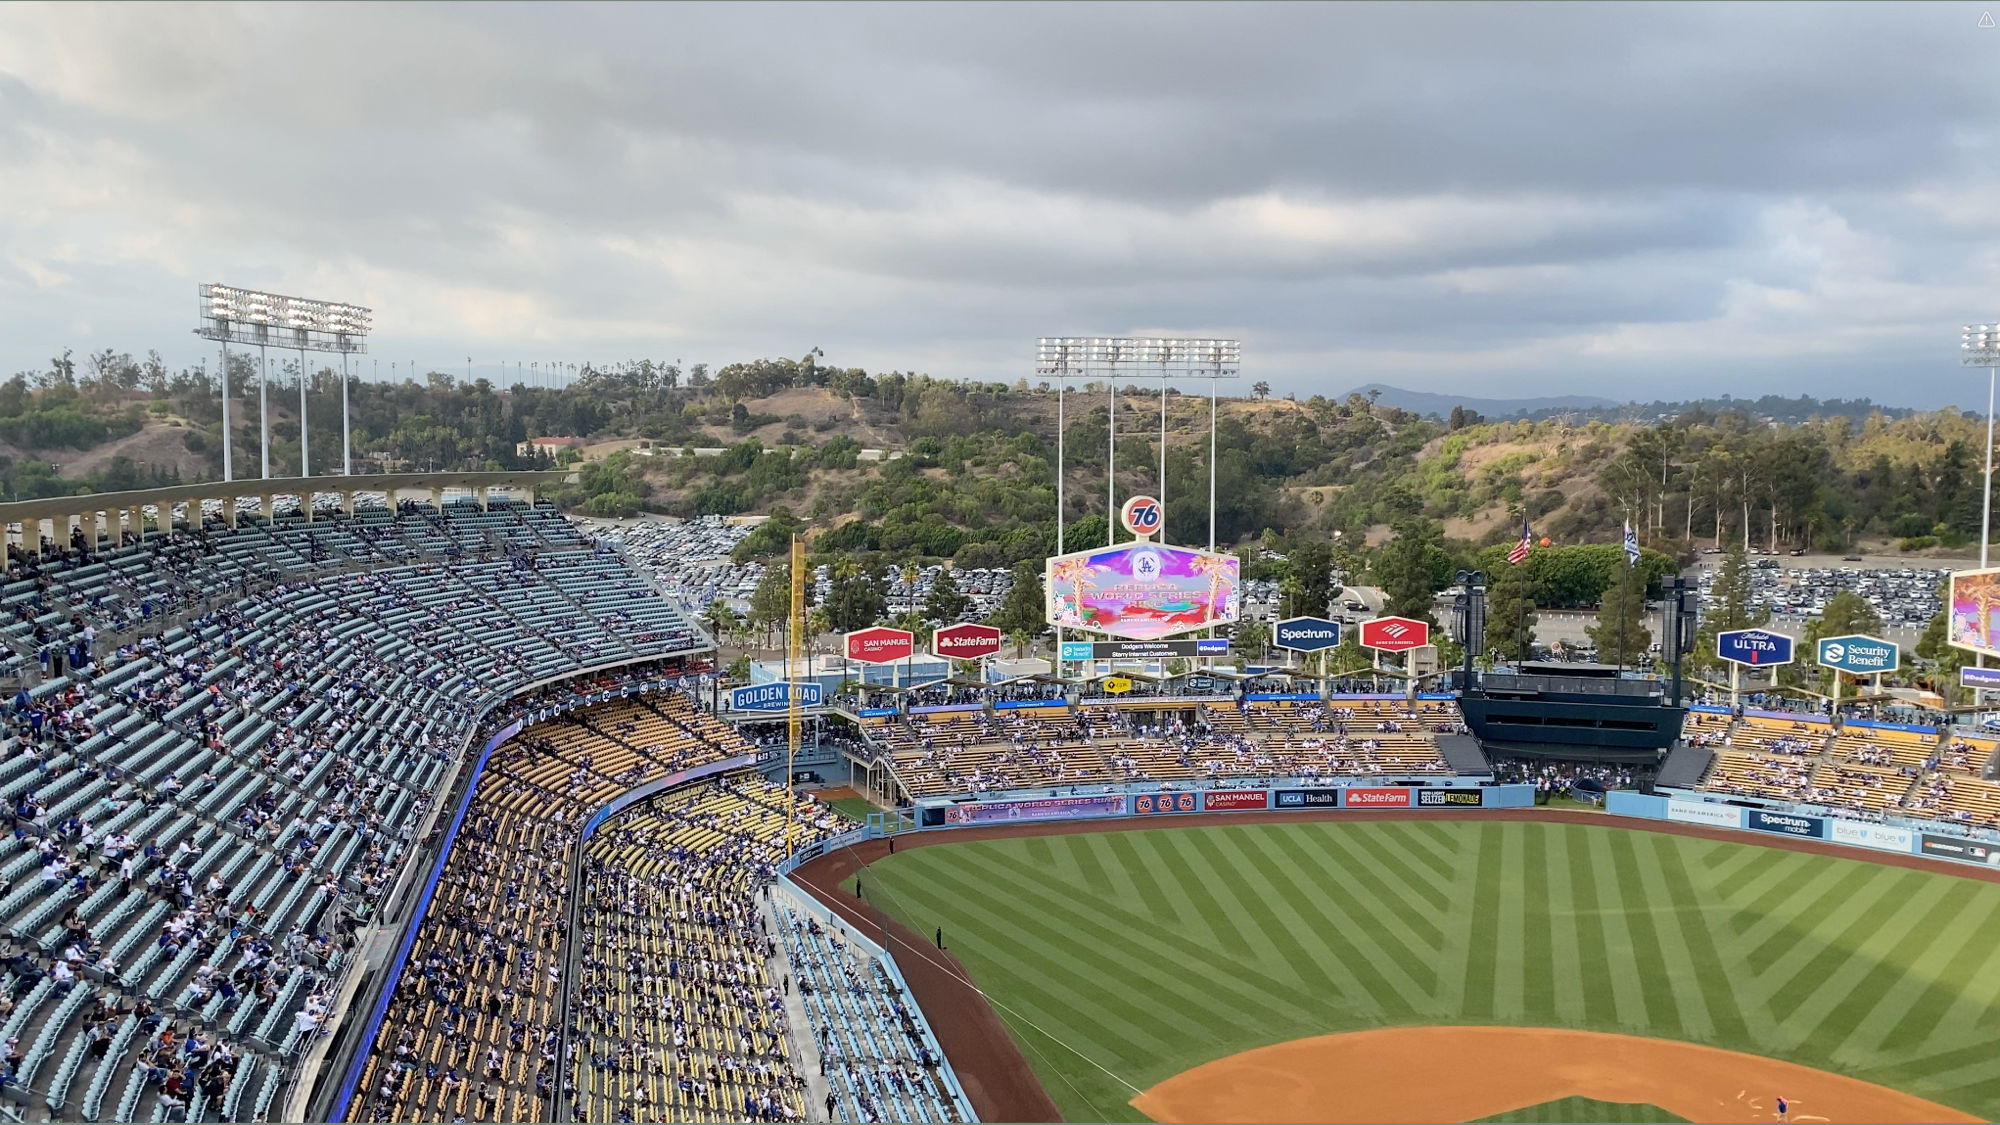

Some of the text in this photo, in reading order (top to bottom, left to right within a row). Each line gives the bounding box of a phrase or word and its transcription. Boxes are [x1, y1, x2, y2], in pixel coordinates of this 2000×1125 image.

[1131, 504, 1158, 527] 76
[1148, 591, 1201, 600] SERIES
[1280, 628, 1332, 641] Spectrum
[880, 638, 910, 646] MANUEL
[1734, 639, 1776, 651] ULTRA
[1848, 644, 1891, 659] Security
[1848, 655, 1885, 666] Benefit
[737, 687, 783, 707] GOLDEN
[763, 701, 791, 709] BREWIN
[1232, 793, 1265, 801] MANUEL
[1282, 794, 1333, 803] UCLA Health
[1421, 795, 1446, 804] SELTZER
[965, 803, 1012, 811] REPLICA
[1054, 798, 1091, 806] SERIES
[1139, 800, 1150, 809] 76
[1160, 799, 1171, 808] 76
[1181, 798, 1192, 806] 76
[949, 811, 957, 819] 76
[1697, 810, 1724, 818] AMERICA
[1760, 813, 1808, 828] Spectrum
[1784, 826, 1807, 834] mobile
[1836, 826, 1858, 836] blue
[1874, 831, 1896, 842] blue
